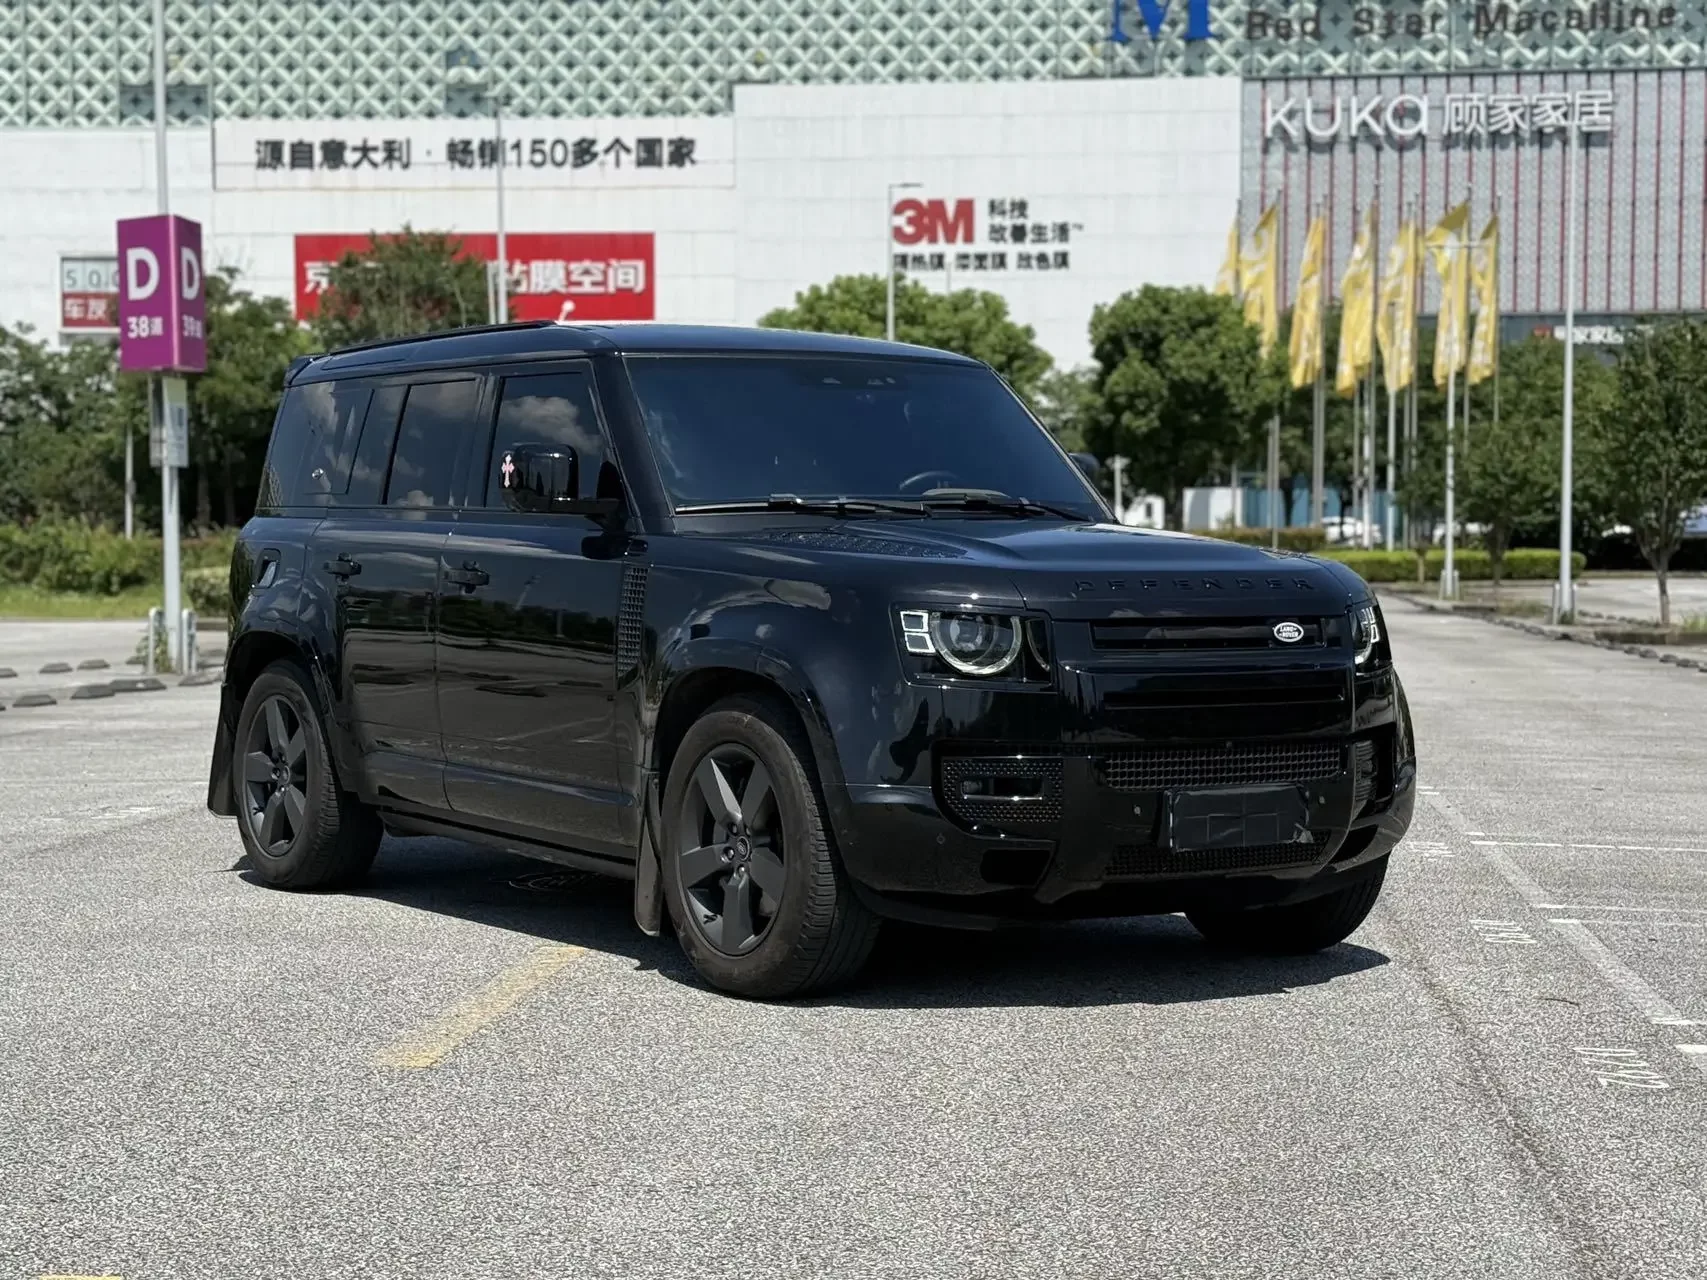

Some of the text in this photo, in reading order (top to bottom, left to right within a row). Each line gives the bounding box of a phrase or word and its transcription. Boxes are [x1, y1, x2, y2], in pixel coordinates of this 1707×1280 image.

[1246, 7, 1322, 42] Red
[1353, 8, 1443, 39] Star
[1442, 90, 1613, 134] 顾家家居
[255, 138, 411, 170] 源自意大利
[892, 198, 974, 244] 3M
[988, 198, 1029, 219] 科技
[127, 247, 161, 301] D
[181, 246, 201, 301] D
[1075, 577, 1315, 592] DEFENDER
